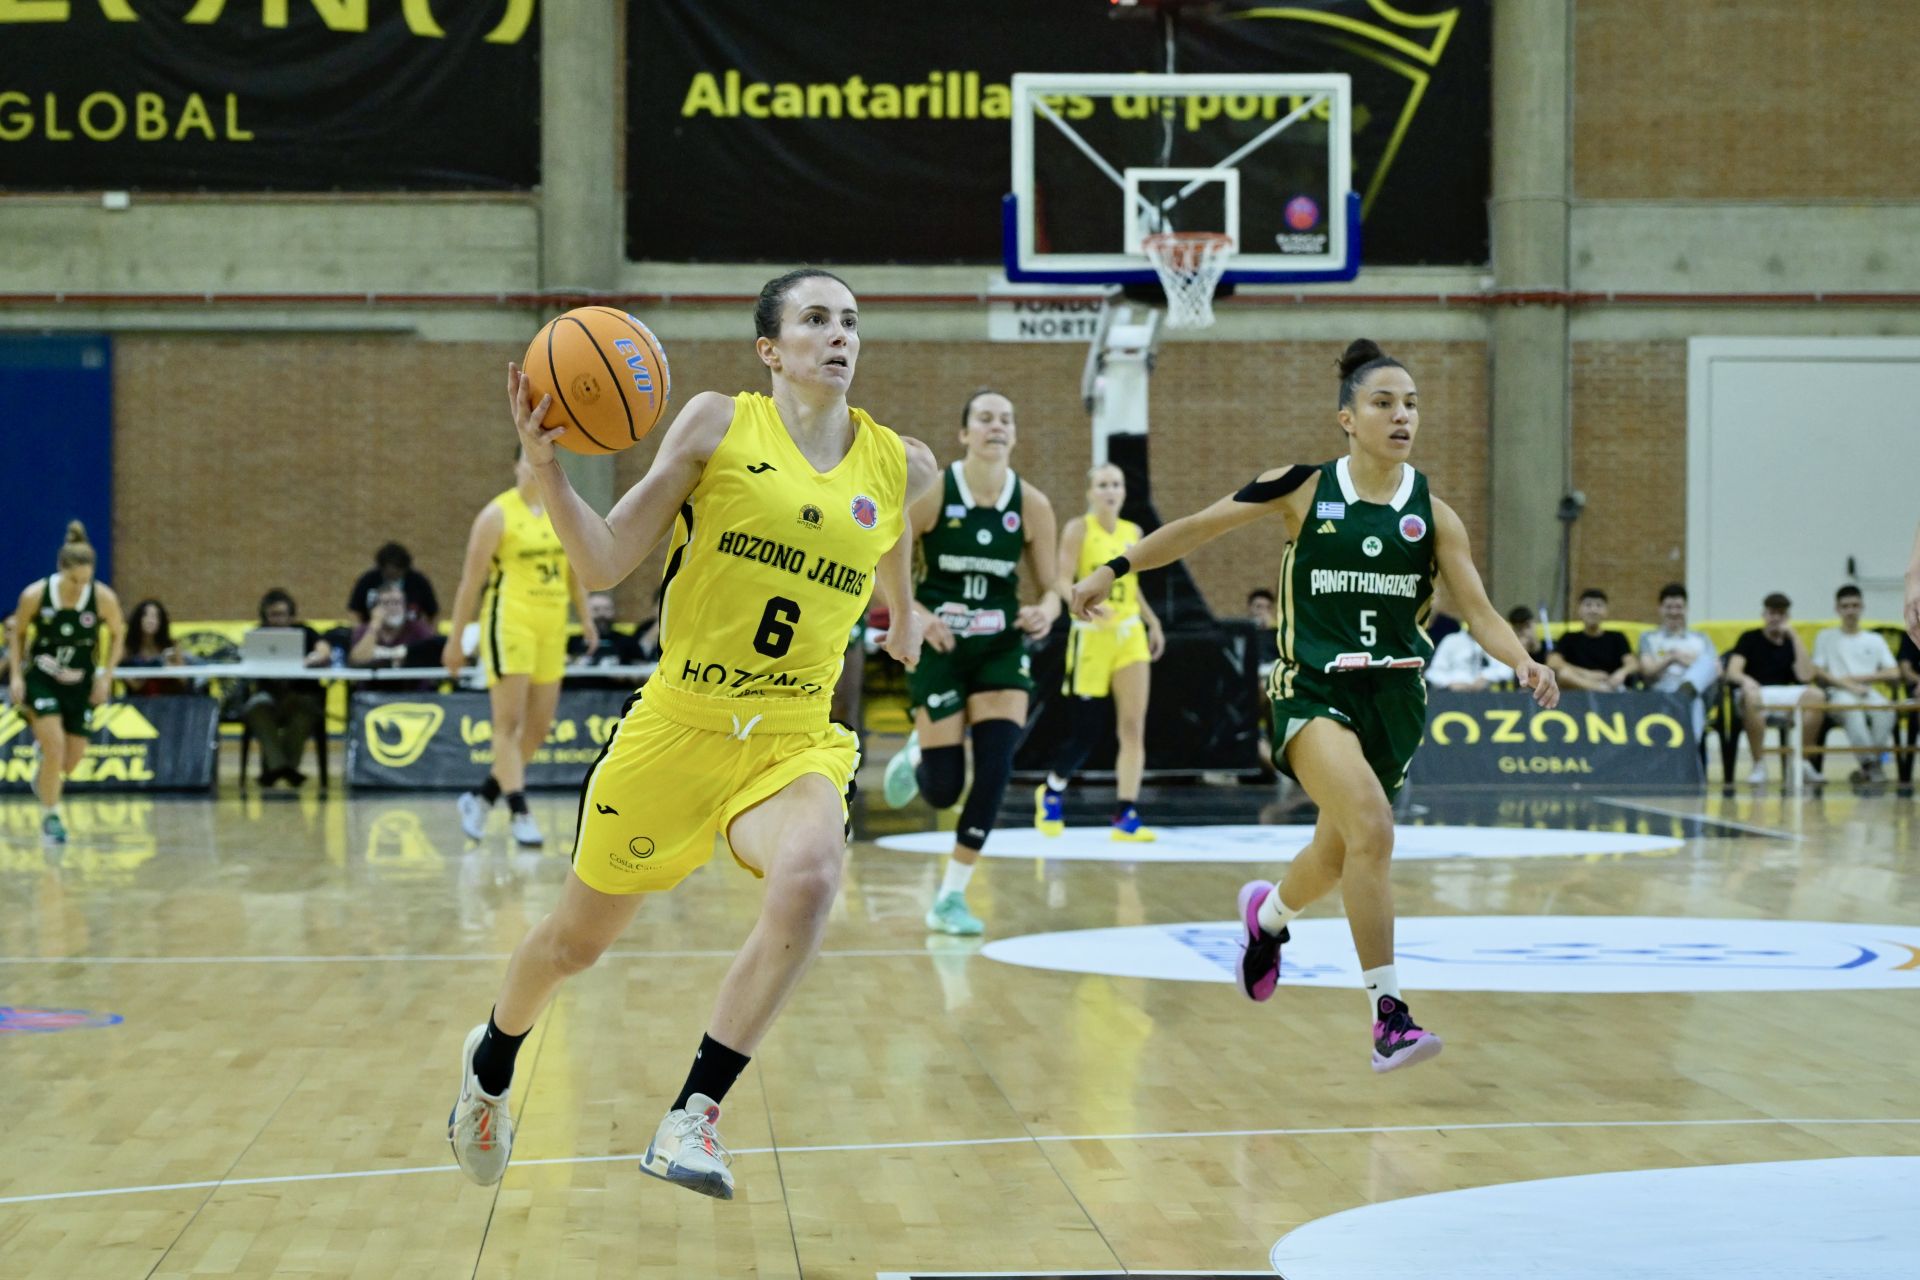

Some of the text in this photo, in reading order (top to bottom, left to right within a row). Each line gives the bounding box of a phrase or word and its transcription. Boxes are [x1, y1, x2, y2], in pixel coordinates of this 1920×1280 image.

[681, 69, 1012, 119] Alcantarilla
[0, 91, 255, 142] GLOBAL
[717, 531, 867, 597] HOZONO JAIRIS
[1311, 569, 1421, 598] PANATHINAIKOS
[962, 574, 988, 601] 10
[753, 596, 801, 659] 6
[1360, 610, 1377, 647] 5
[1420, 709, 1685, 748] OZONO
[1498, 756, 1593, 774] GLOBAL
